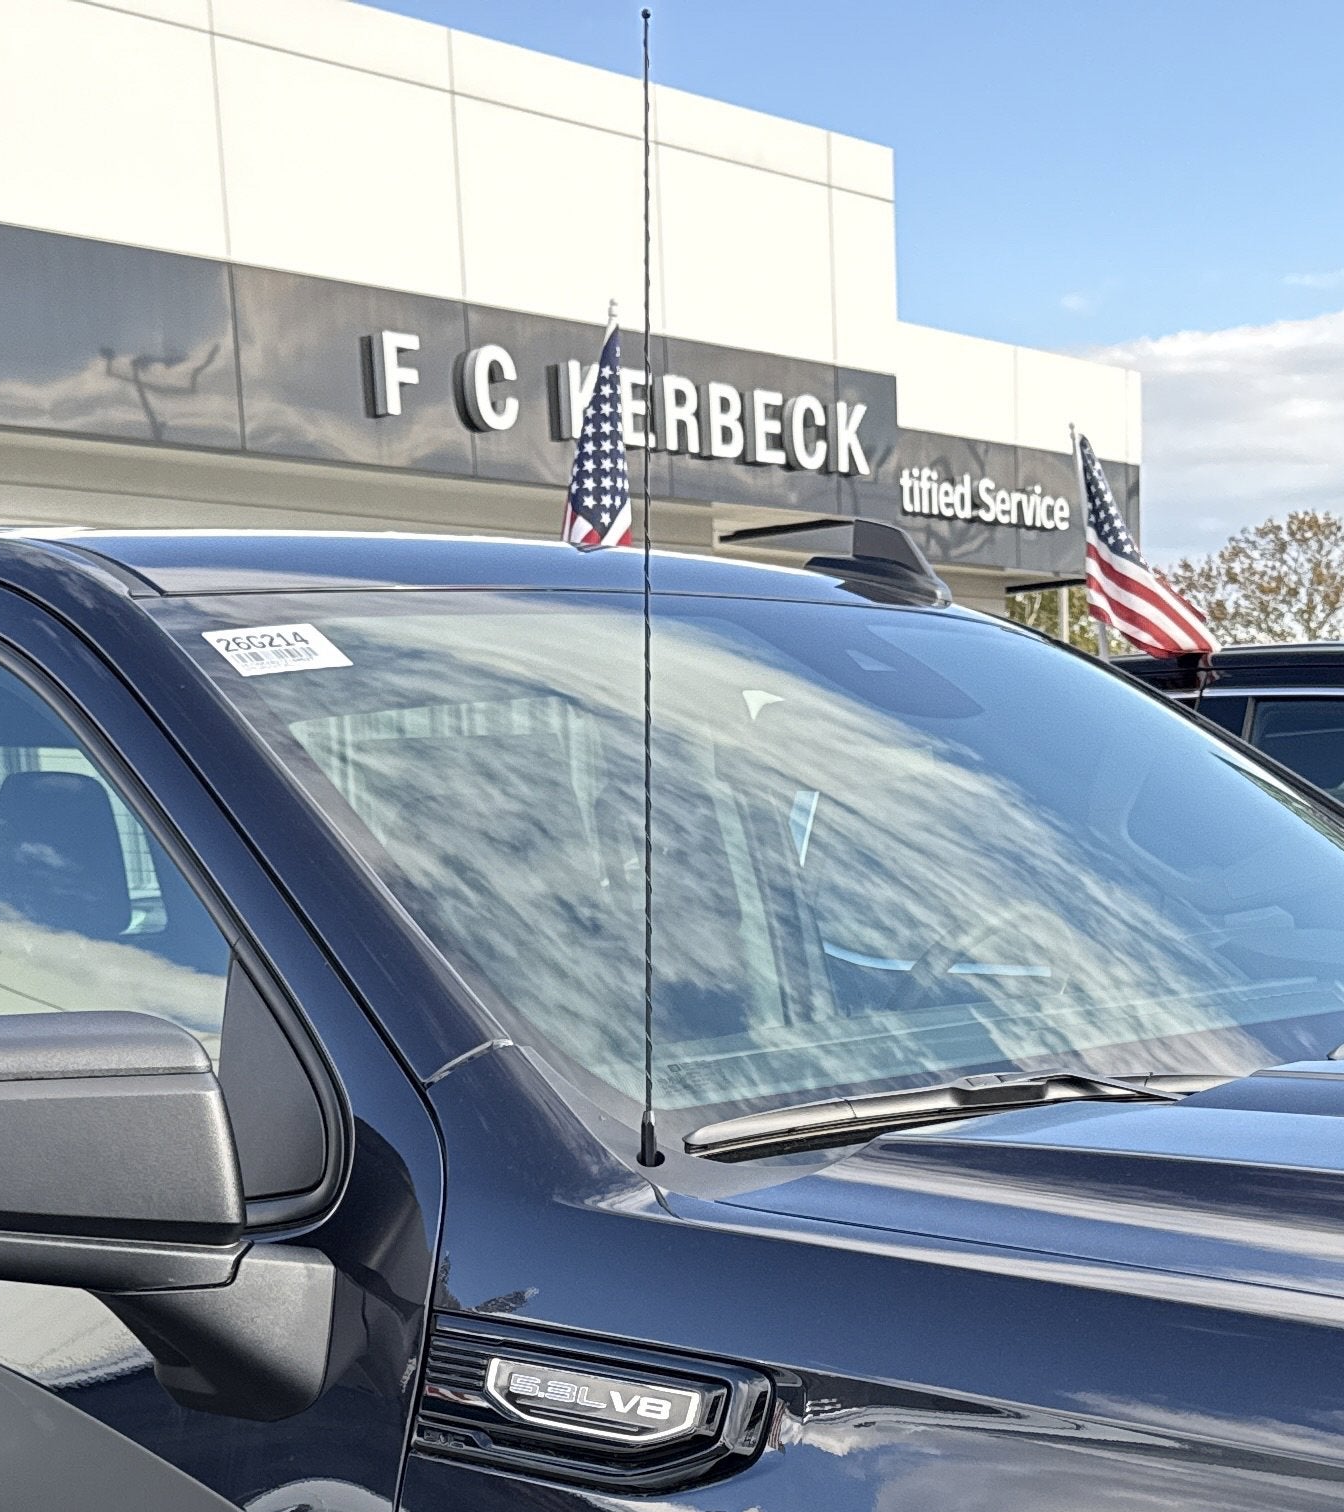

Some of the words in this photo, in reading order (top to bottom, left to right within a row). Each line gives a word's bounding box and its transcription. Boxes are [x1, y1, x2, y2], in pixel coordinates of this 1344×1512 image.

[374, 329, 420, 416] F
[466, 344, 520, 431] C
[564, 359, 870, 476] KERBECK
[978, 477, 1070, 531] Service
[216, 631, 309, 652] 26G214
